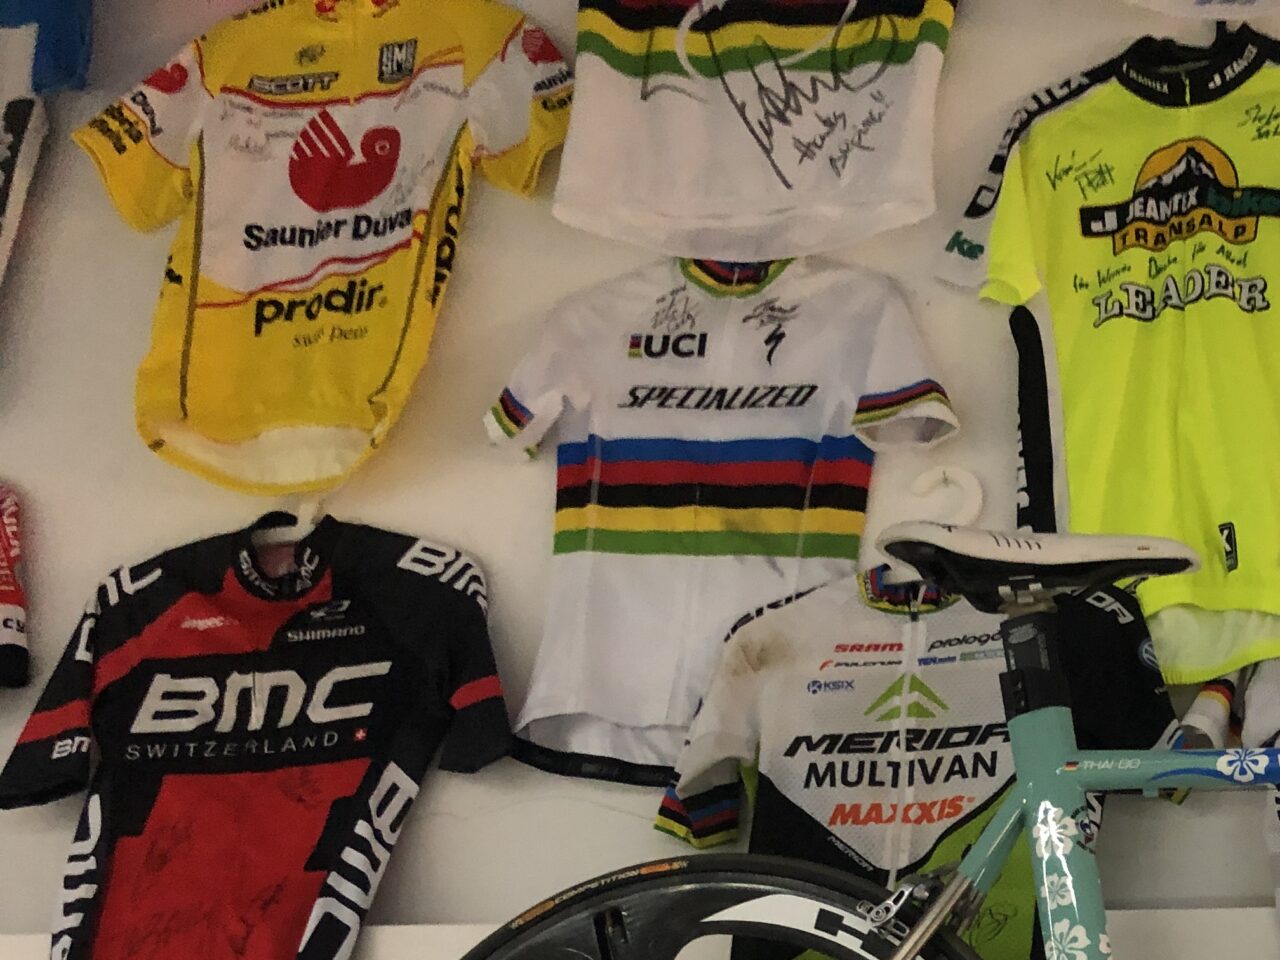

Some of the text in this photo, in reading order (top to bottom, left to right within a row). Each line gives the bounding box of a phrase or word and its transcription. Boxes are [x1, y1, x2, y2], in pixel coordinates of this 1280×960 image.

[243, 215, 348, 252] Saunier
[1120, 213, 1247, 245] TRANSALP
[1092, 264, 1271, 329] LEADER
[643, 332, 708, 359] UCI
[618, 384, 818, 411] SPECIALIZED
[287, 624, 366, 643] SHIMANO
[834, 642, 905, 653] SRAM
[130, 660, 392, 734] BMC
[126, 731, 340, 762] SWITZERLAND
[803, 751, 998, 790] MULTIVAN
[827, 795, 965, 827] MAXXIS
